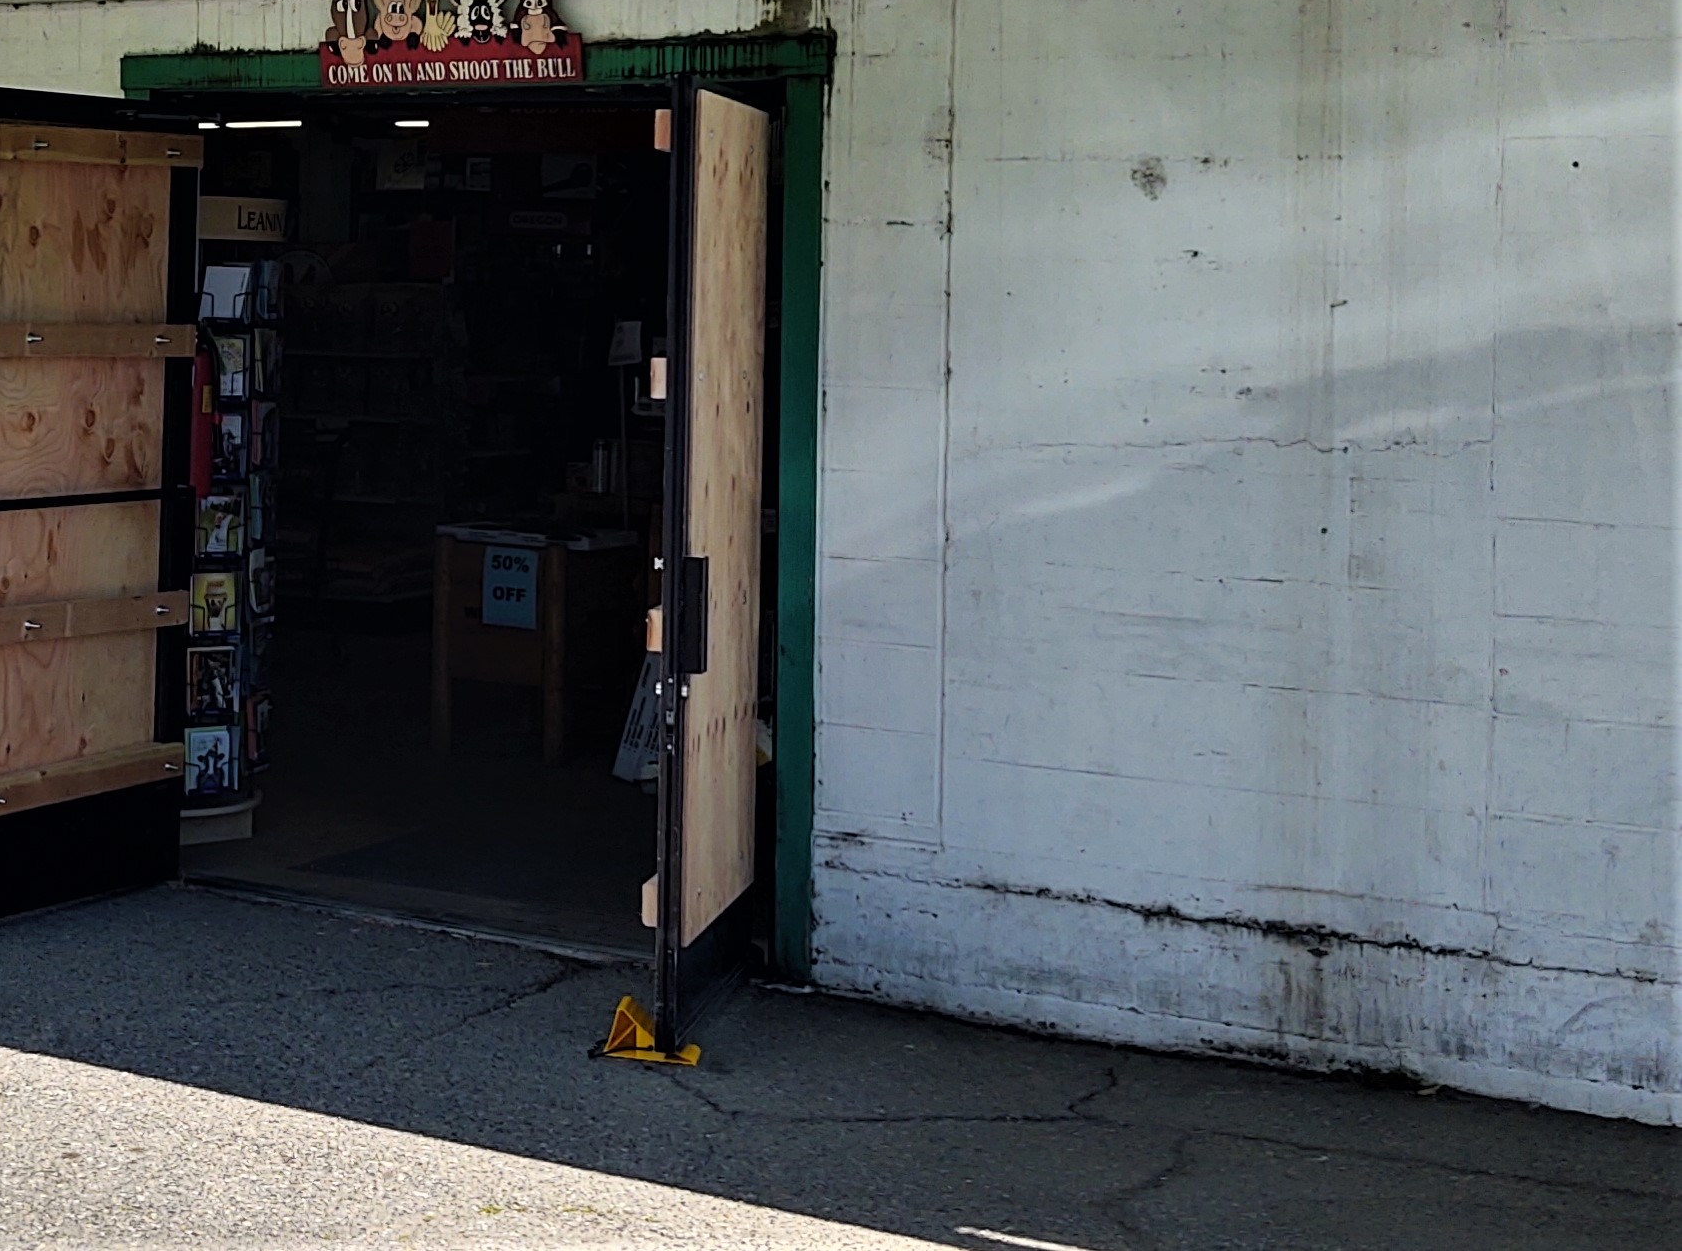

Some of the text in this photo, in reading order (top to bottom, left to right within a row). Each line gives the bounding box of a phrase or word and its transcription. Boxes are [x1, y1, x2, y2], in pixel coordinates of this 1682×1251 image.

[328, 57, 576, 84] COME ON IN AND SHOOT THE BULL
[491, 554, 530, 573] 50%
[492, 586, 527, 603] OFF
